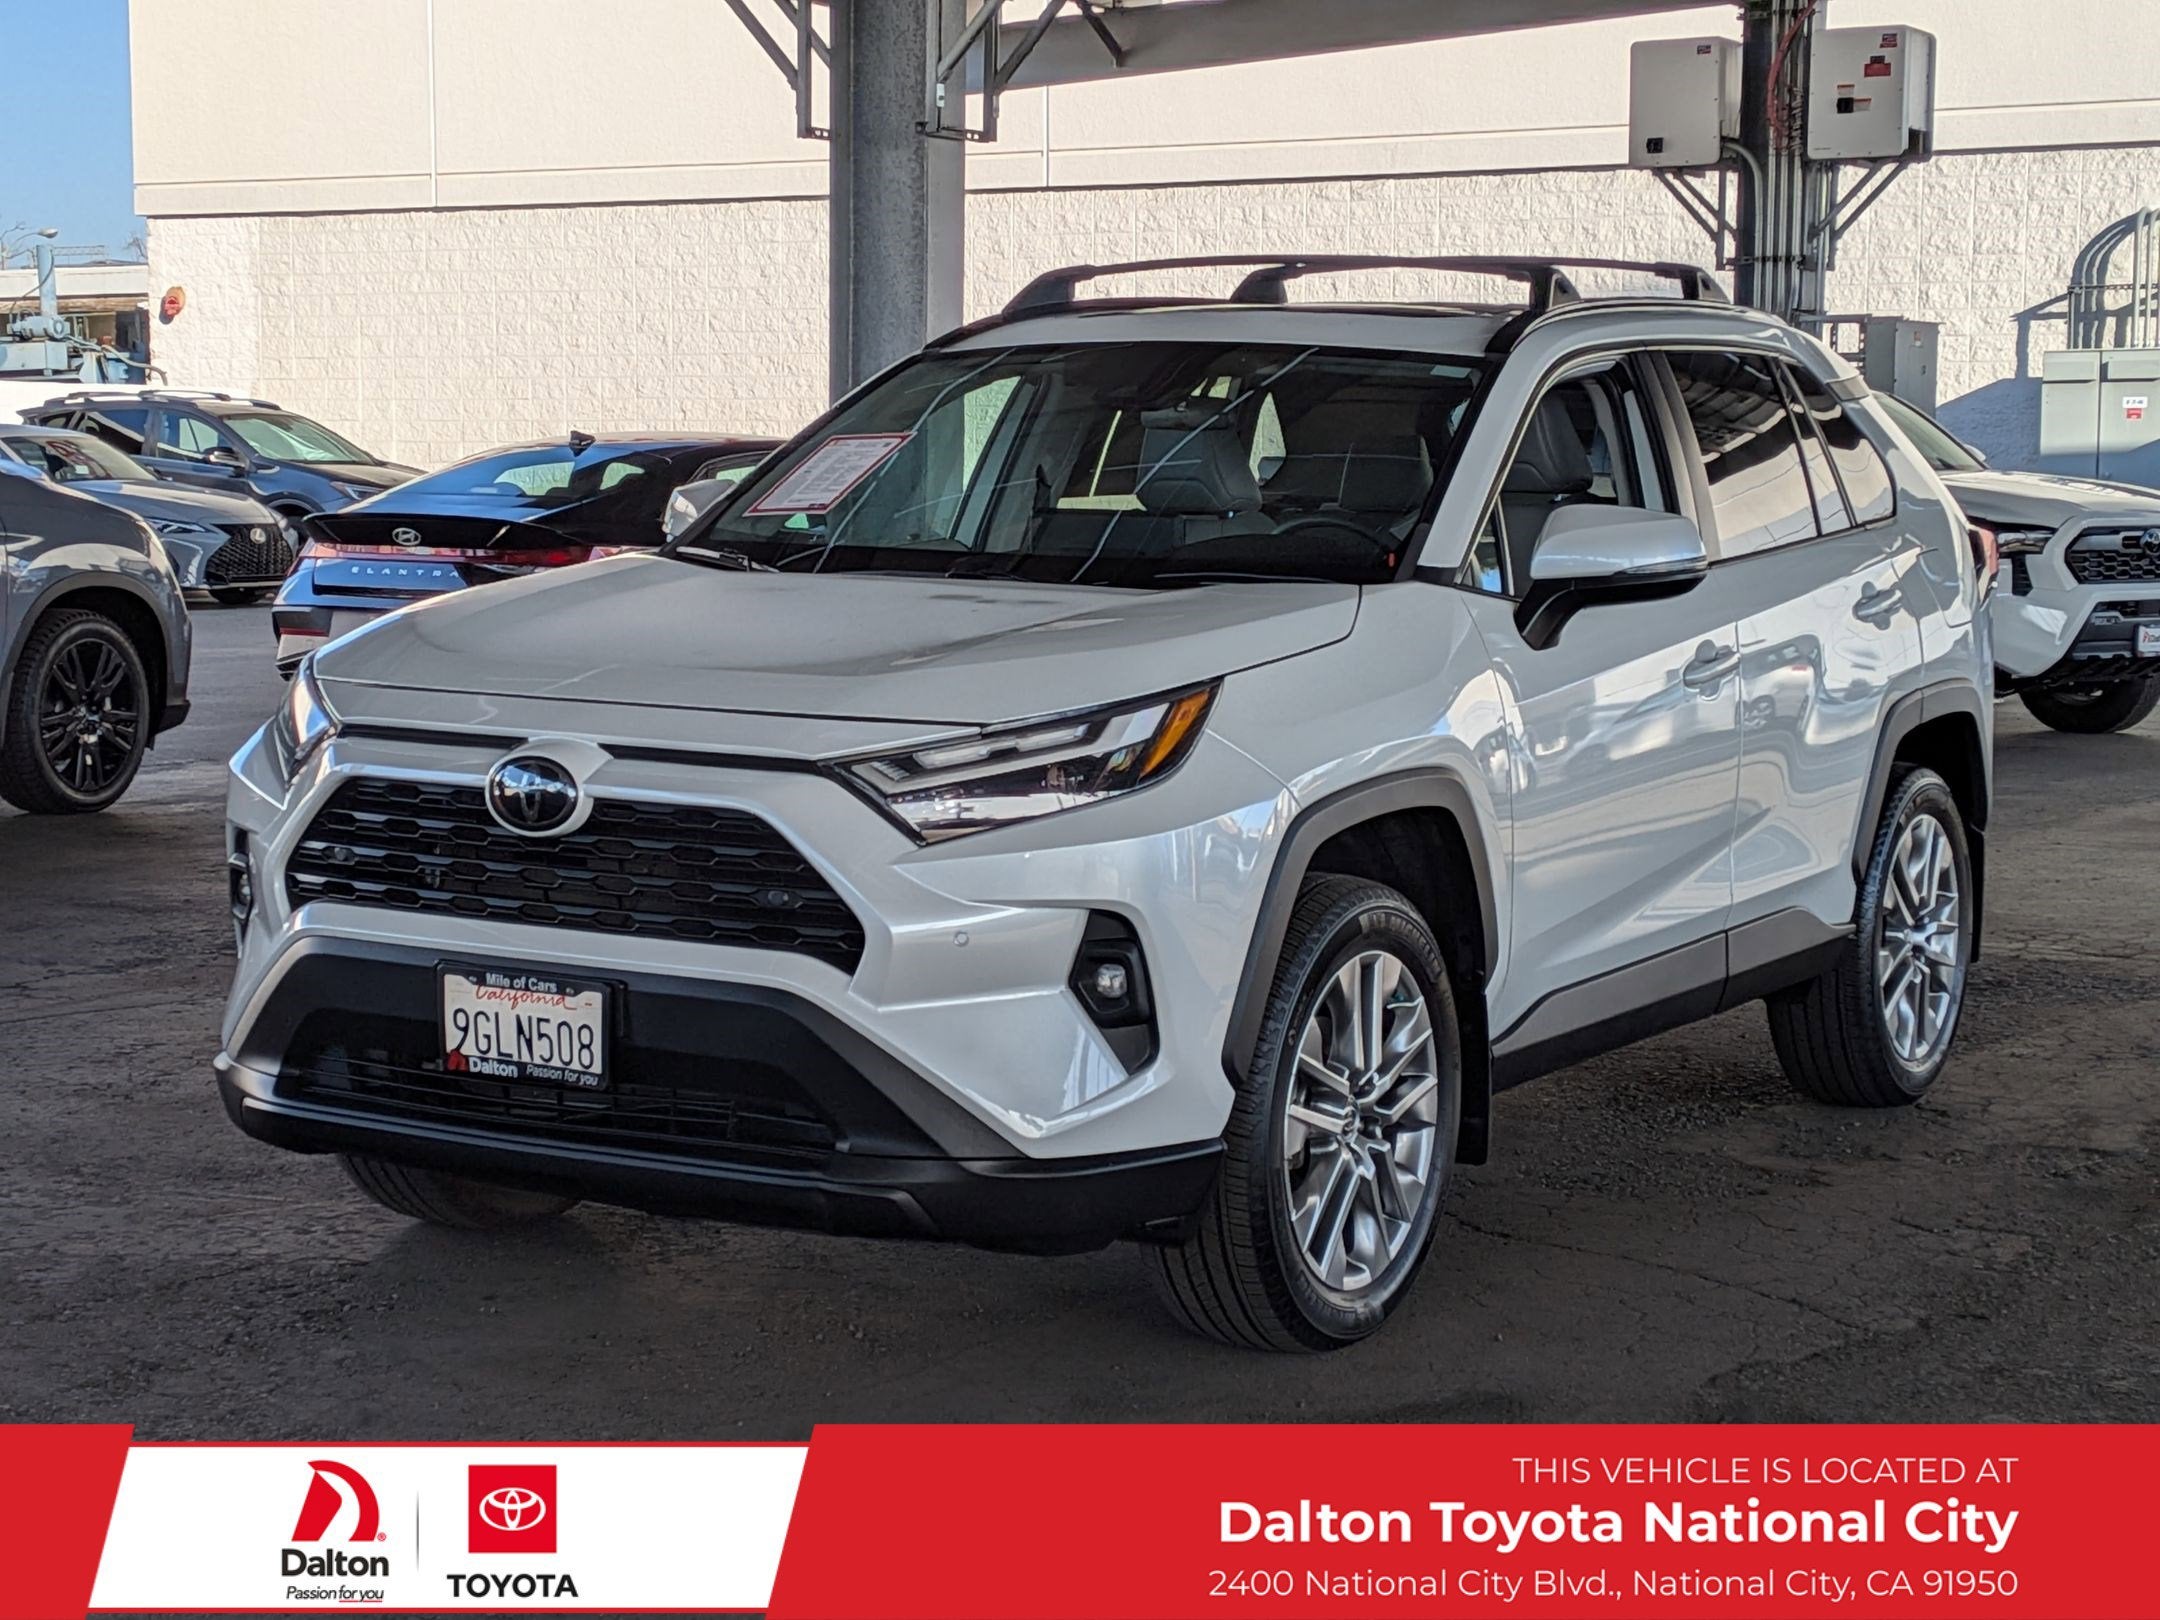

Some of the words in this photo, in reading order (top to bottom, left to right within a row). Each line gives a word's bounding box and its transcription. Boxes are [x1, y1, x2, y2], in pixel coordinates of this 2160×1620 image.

[351, 565, 459, 578] ELANTRA
[485, 972, 511, 988] Mile
[513, 976, 526, 989] of
[528, 978, 557, 993] Cars
[475, 984, 577, 1010] California
[453, 1007, 594, 1070] 9GLN508
[468, 1056, 518, 1079] Dalton
[526, 1064, 562, 1080] Passion
[564, 1069, 578, 1083] for
[579, 1076, 599, 1087] you
